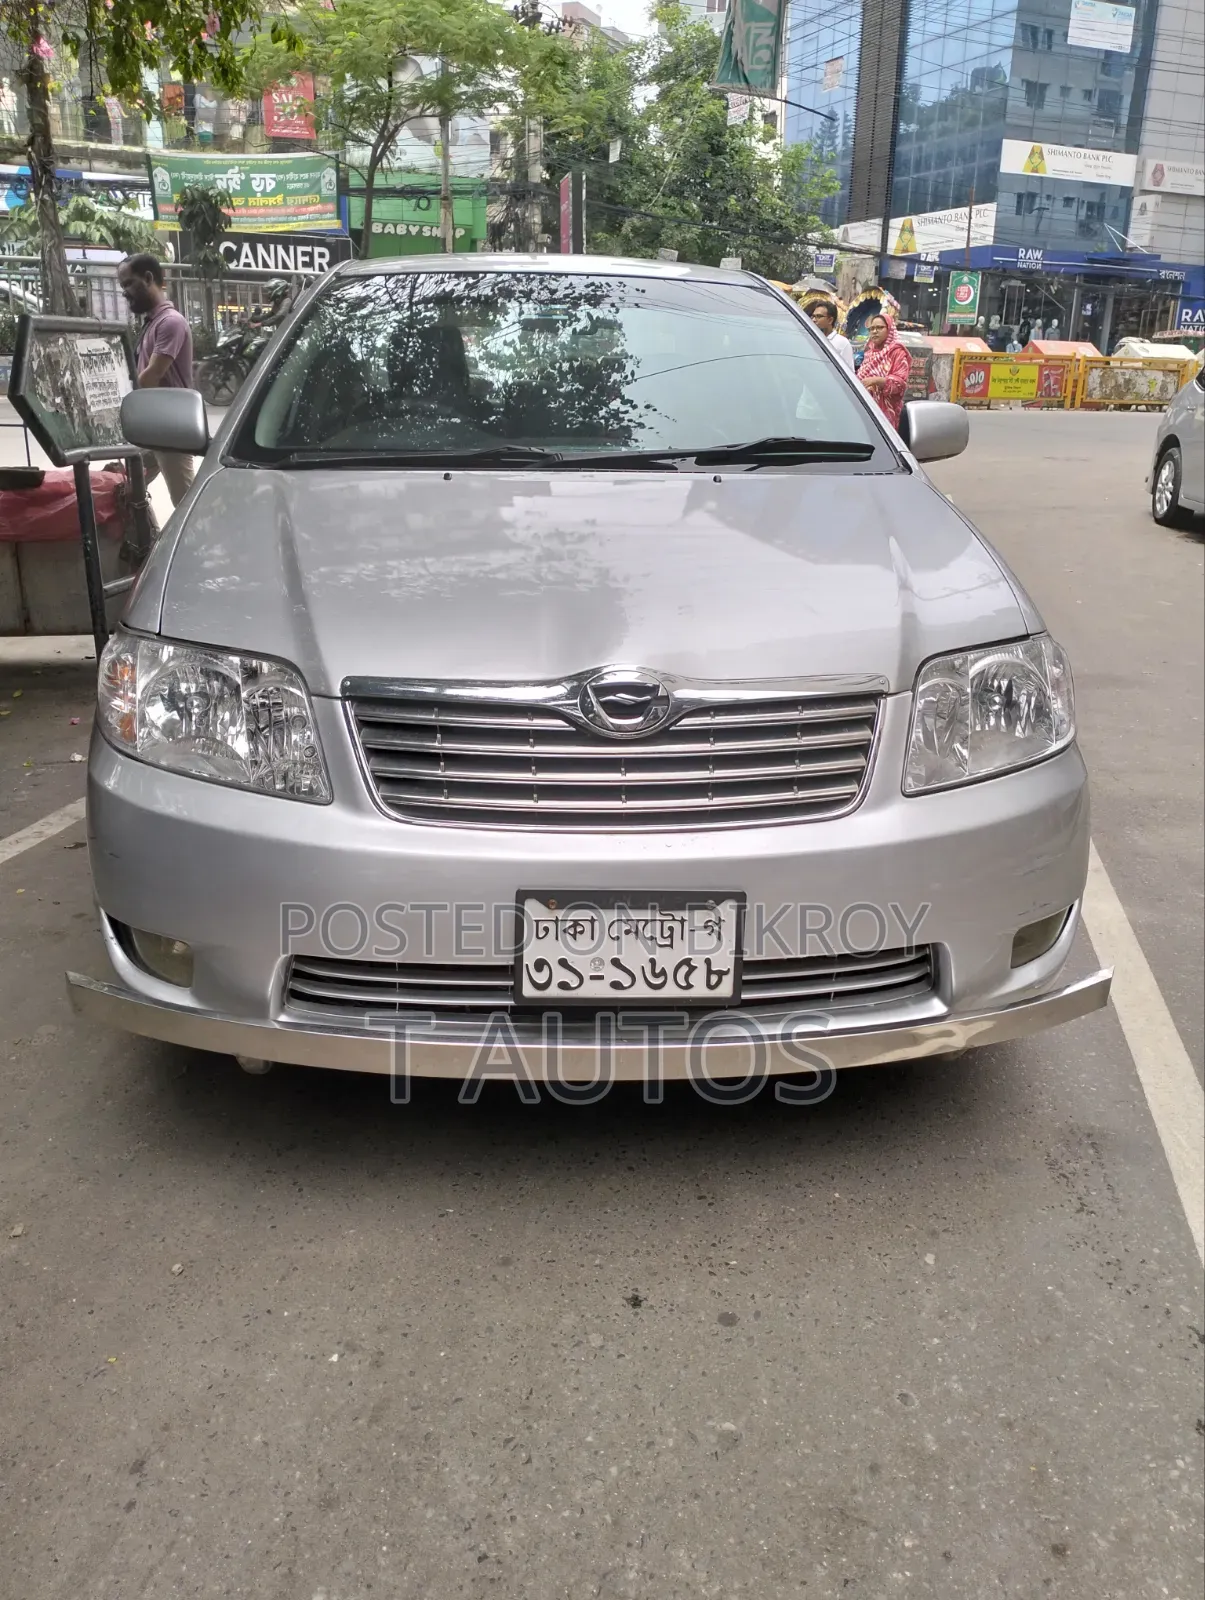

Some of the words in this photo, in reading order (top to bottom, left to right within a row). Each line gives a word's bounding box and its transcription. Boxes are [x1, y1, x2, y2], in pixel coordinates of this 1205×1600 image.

[1046, 147, 1082, 160] SHIMANTO
[1083, 152, 1101, 162] BANK
[916, 213, 953, 228] SHIMANTO
[204, 240, 331, 273] CANNER
[1017, 261, 1042, 270] NATION
[1181, 308, 1204, 323] RA
[533, 915, 598, 942] ঢাকা
[525, 956, 731, 991] ৩১-১৬৫৮
